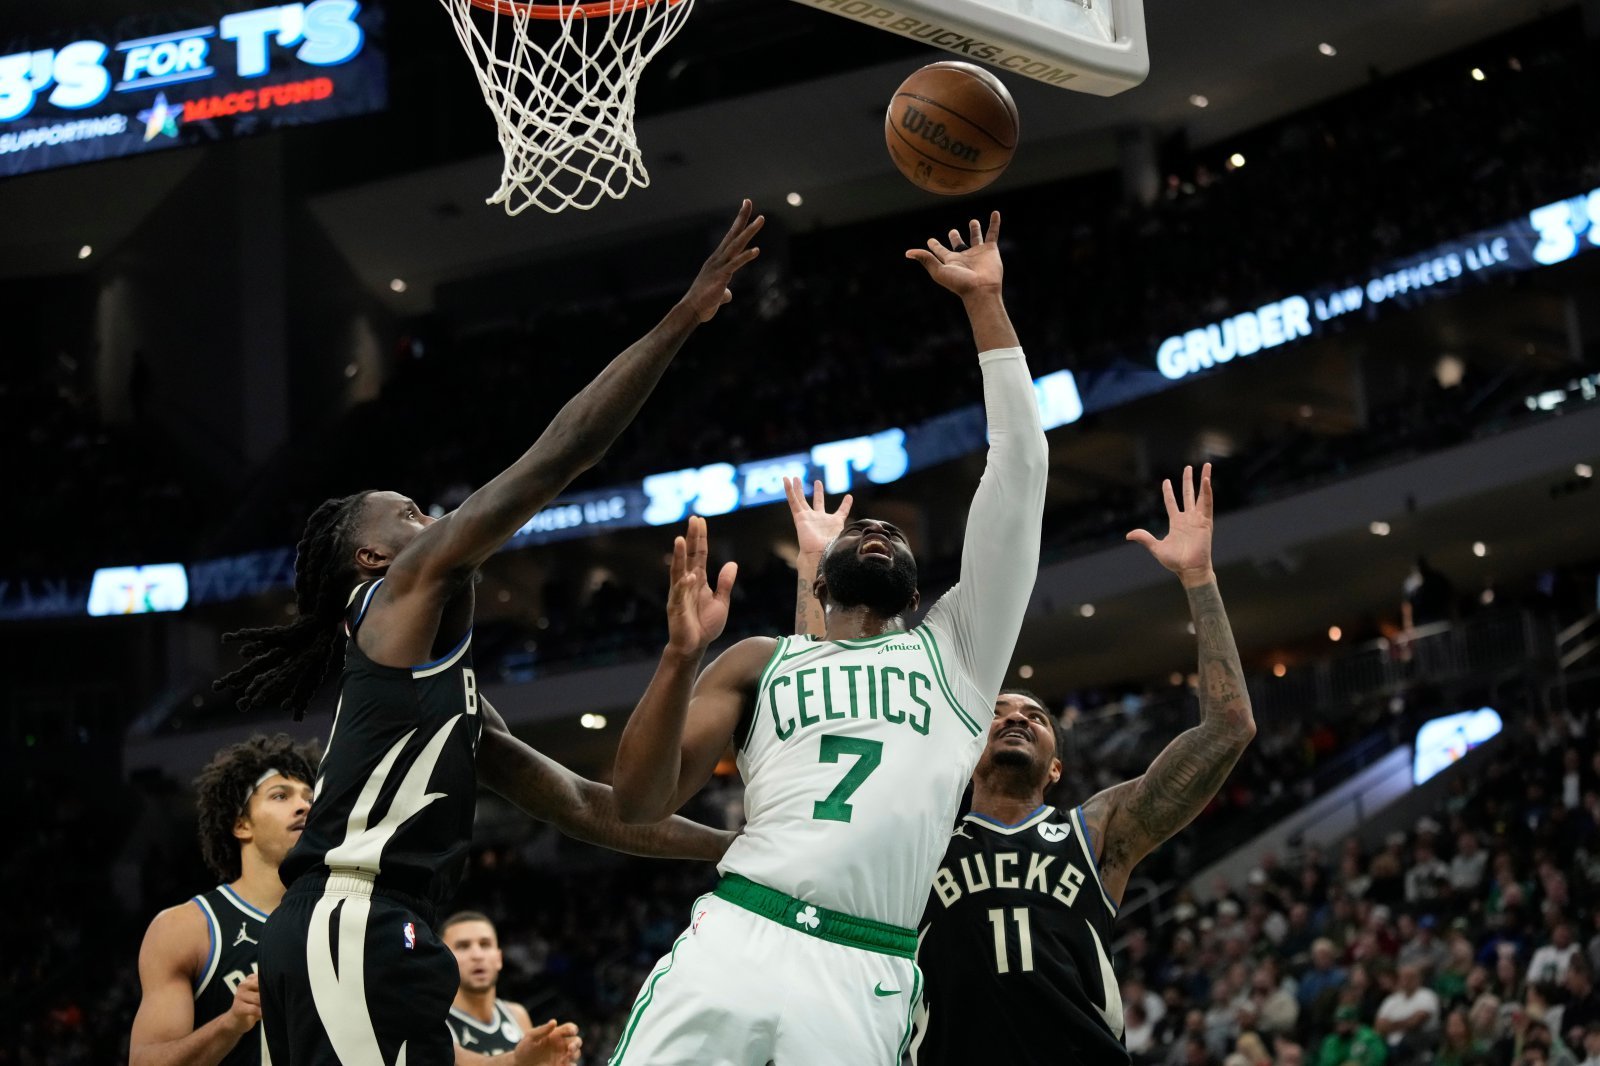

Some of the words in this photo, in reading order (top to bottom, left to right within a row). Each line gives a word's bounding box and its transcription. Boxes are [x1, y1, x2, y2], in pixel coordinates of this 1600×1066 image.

[0, 41, 112, 122] 3'S
[123, 38, 209, 81] FOR
[220, 0, 365, 77] T'S
[183, 93, 256, 122] MACC
[258, 77, 334, 109] FUND
[902, 105, 980, 163] Wilson
[1157, 296, 1312, 380] GRUBER
[1315, 286, 1364, 320] LAW
[1366, 252, 1463, 303] OFFICES
[1465, 237, 1509, 271] LLC
[877, 643, 921, 654] Amica
[769, 665, 931, 741] CELTICS
[812, 734, 884, 823] 7
[932, 852, 1086, 908] BUCKS
[988, 907, 1034, 974] 11
